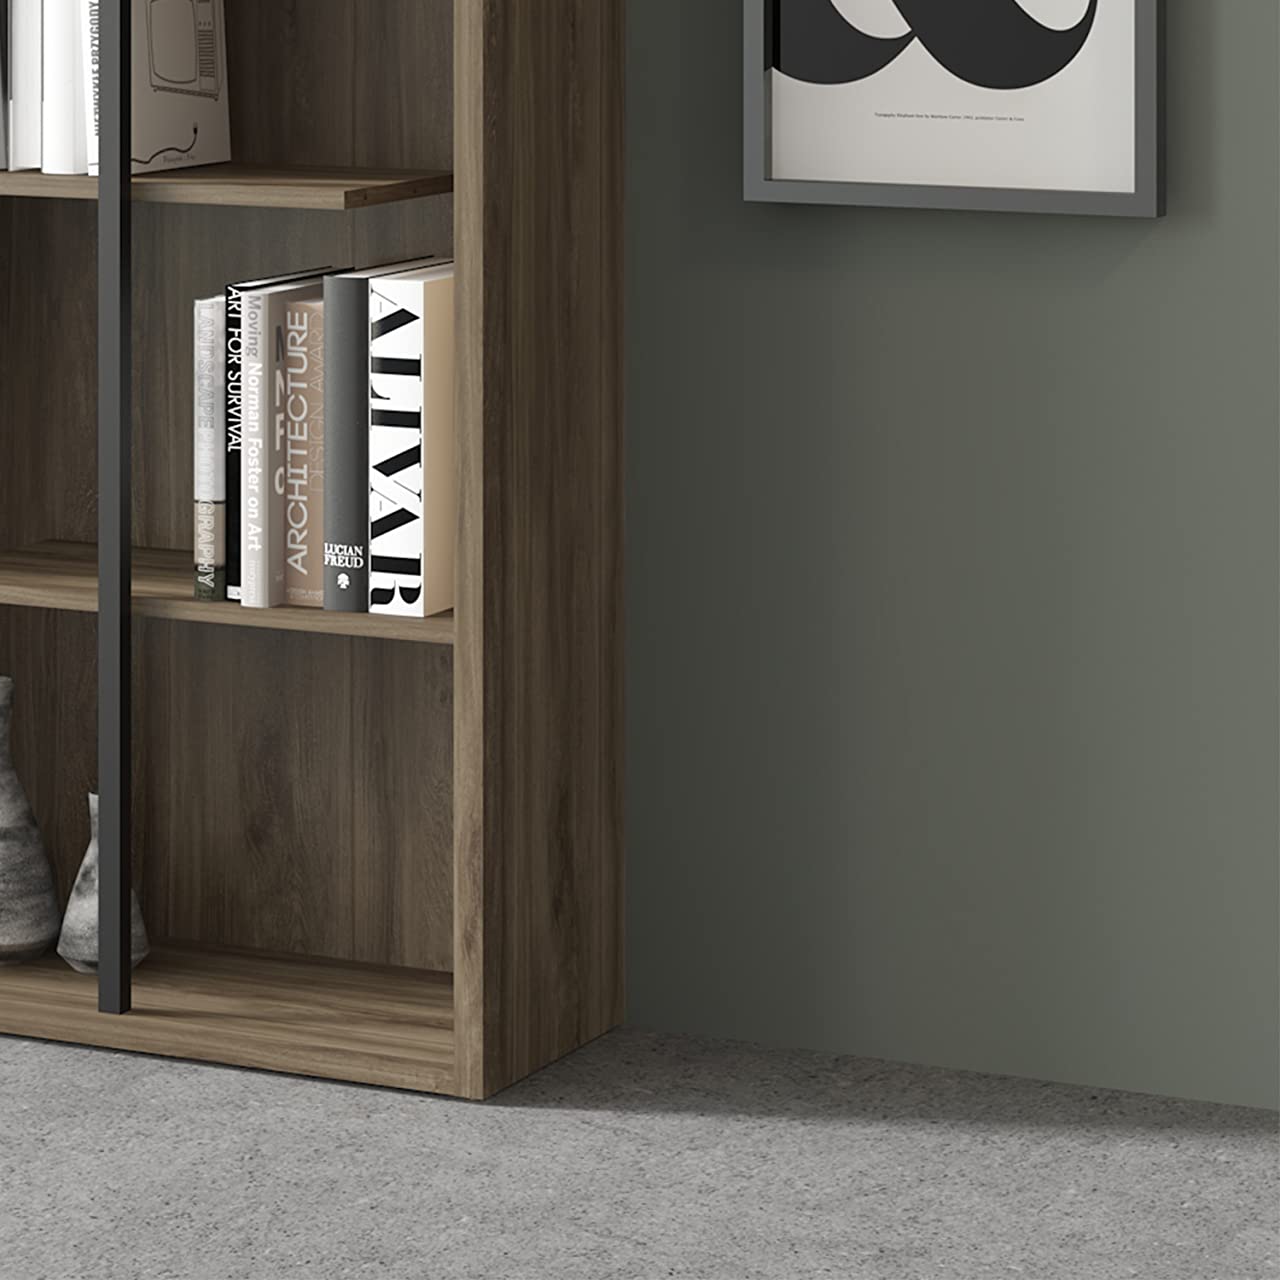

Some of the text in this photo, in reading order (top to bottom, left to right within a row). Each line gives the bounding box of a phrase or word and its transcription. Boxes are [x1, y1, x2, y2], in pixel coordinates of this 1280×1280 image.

[227, 327, 242, 365] FOR
[246, 295, 262, 358] Moving
[227, 370, 242, 453] SURVIVAL
[247, 362, 263, 432] Norman
[247, 437, 263, 493] Foster
[287, 311, 308, 576] ARCHITECTURE
[370, 283, 422, 607] ALIVAR
[247, 496, 259, 519] on
[247, 523, 263, 552] Art
[324, 542, 363, 557] LUCIAN
[324, 554, 364, 569] FREUD
